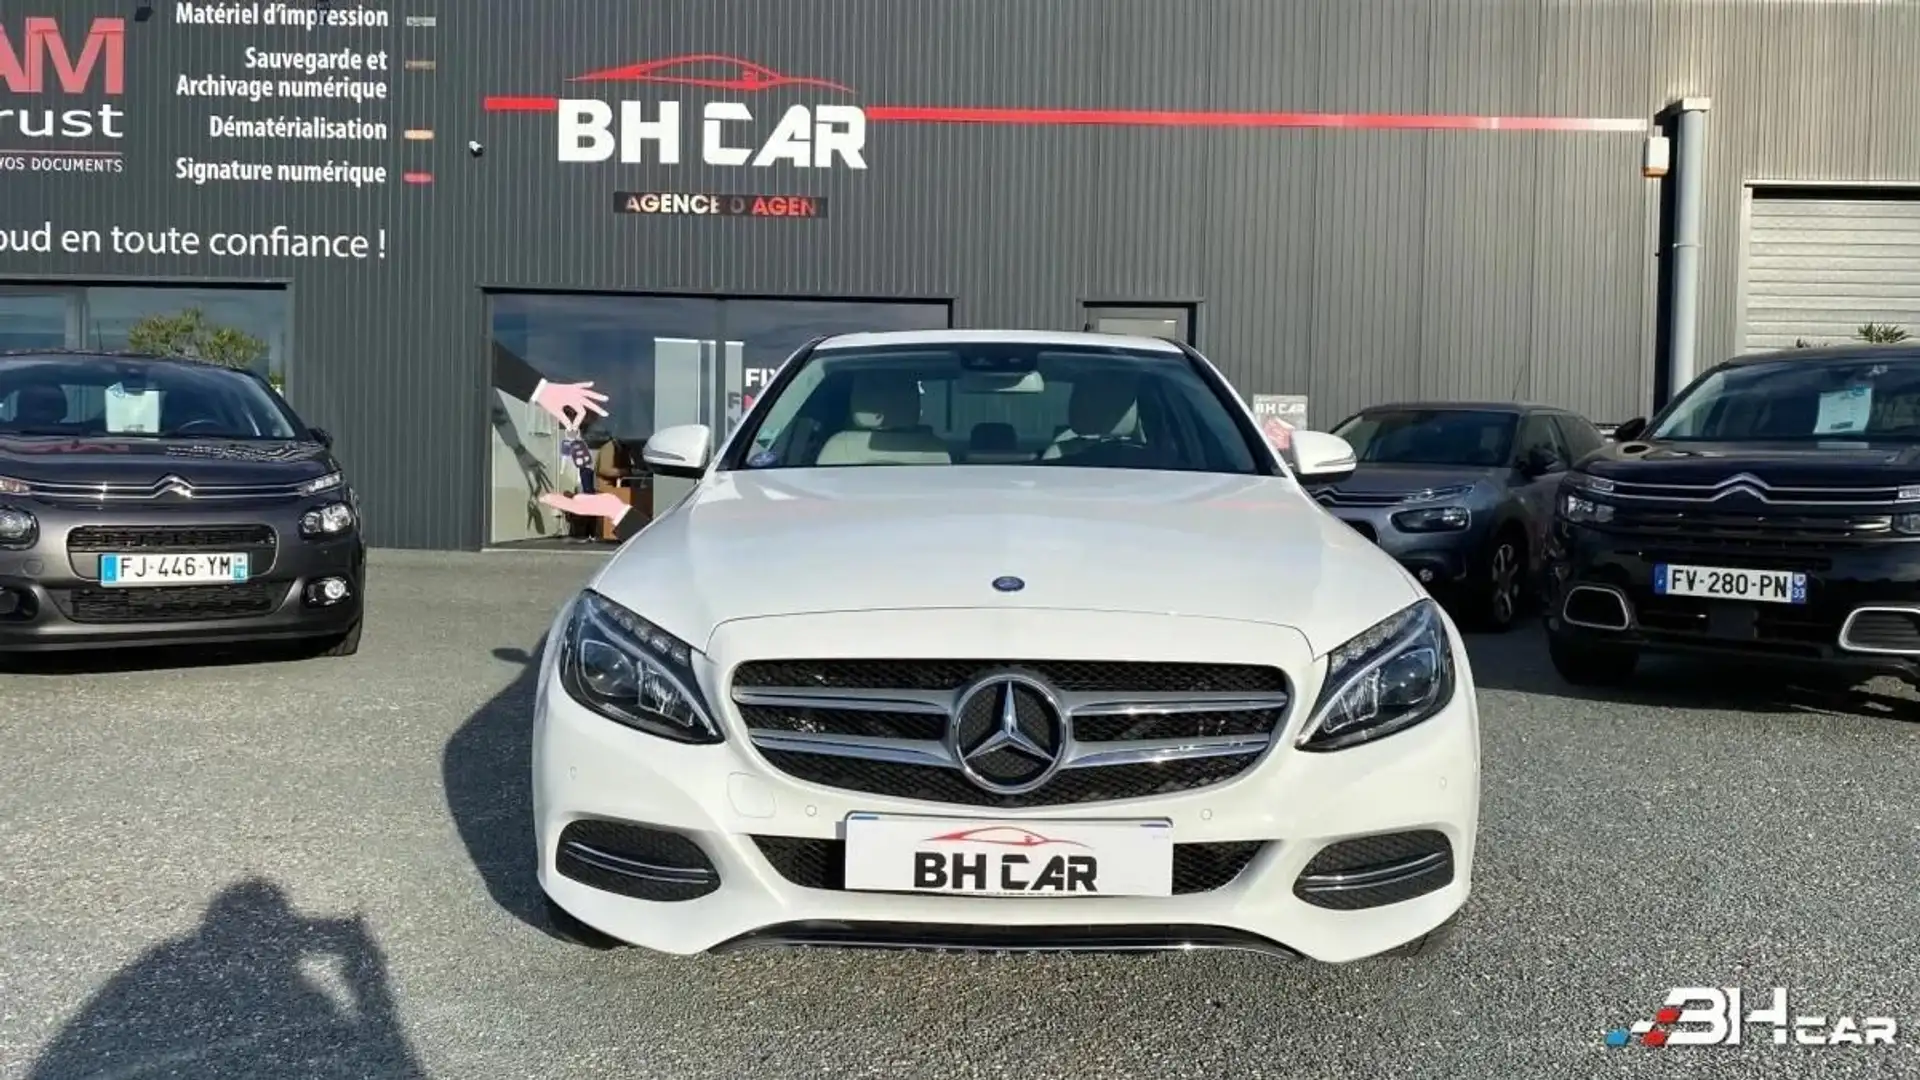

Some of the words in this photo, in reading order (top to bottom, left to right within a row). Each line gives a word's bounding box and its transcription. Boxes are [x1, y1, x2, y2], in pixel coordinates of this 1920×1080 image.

[175, 2, 259, 25] Matériel
[245, 47, 362, 74] Sauvegarde
[366, 50, 389, 70] et
[176, 74, 273, 102] Archivage
[278, 76, 388, 103] numérique
[209, 115, 388, 140] Dématérialisation
[558, 98, 680, 164] BH
[703, 102, 868, 170] CAR
[32, 157, 123, 173] DOCUMENTS
[176, 157, 273, 184] Signature
[278, 160, 387, 188] numérique
[625, 193, 721, 215] AGENCE
[752, 196, 816, 217] AGEN
[61, 230, 101, 253] en
[110, 225, 200, 255] toute
[209, 225, 369, 259] confiance
[378, 228, 386, 259] !
[120, 556, 231, 578] FJ-446-YM
[1671, 568, 1788, 598] FV-280-PN
[913, 851, 987, 890] BH
[1000, 854, 1099, 893] CAR
